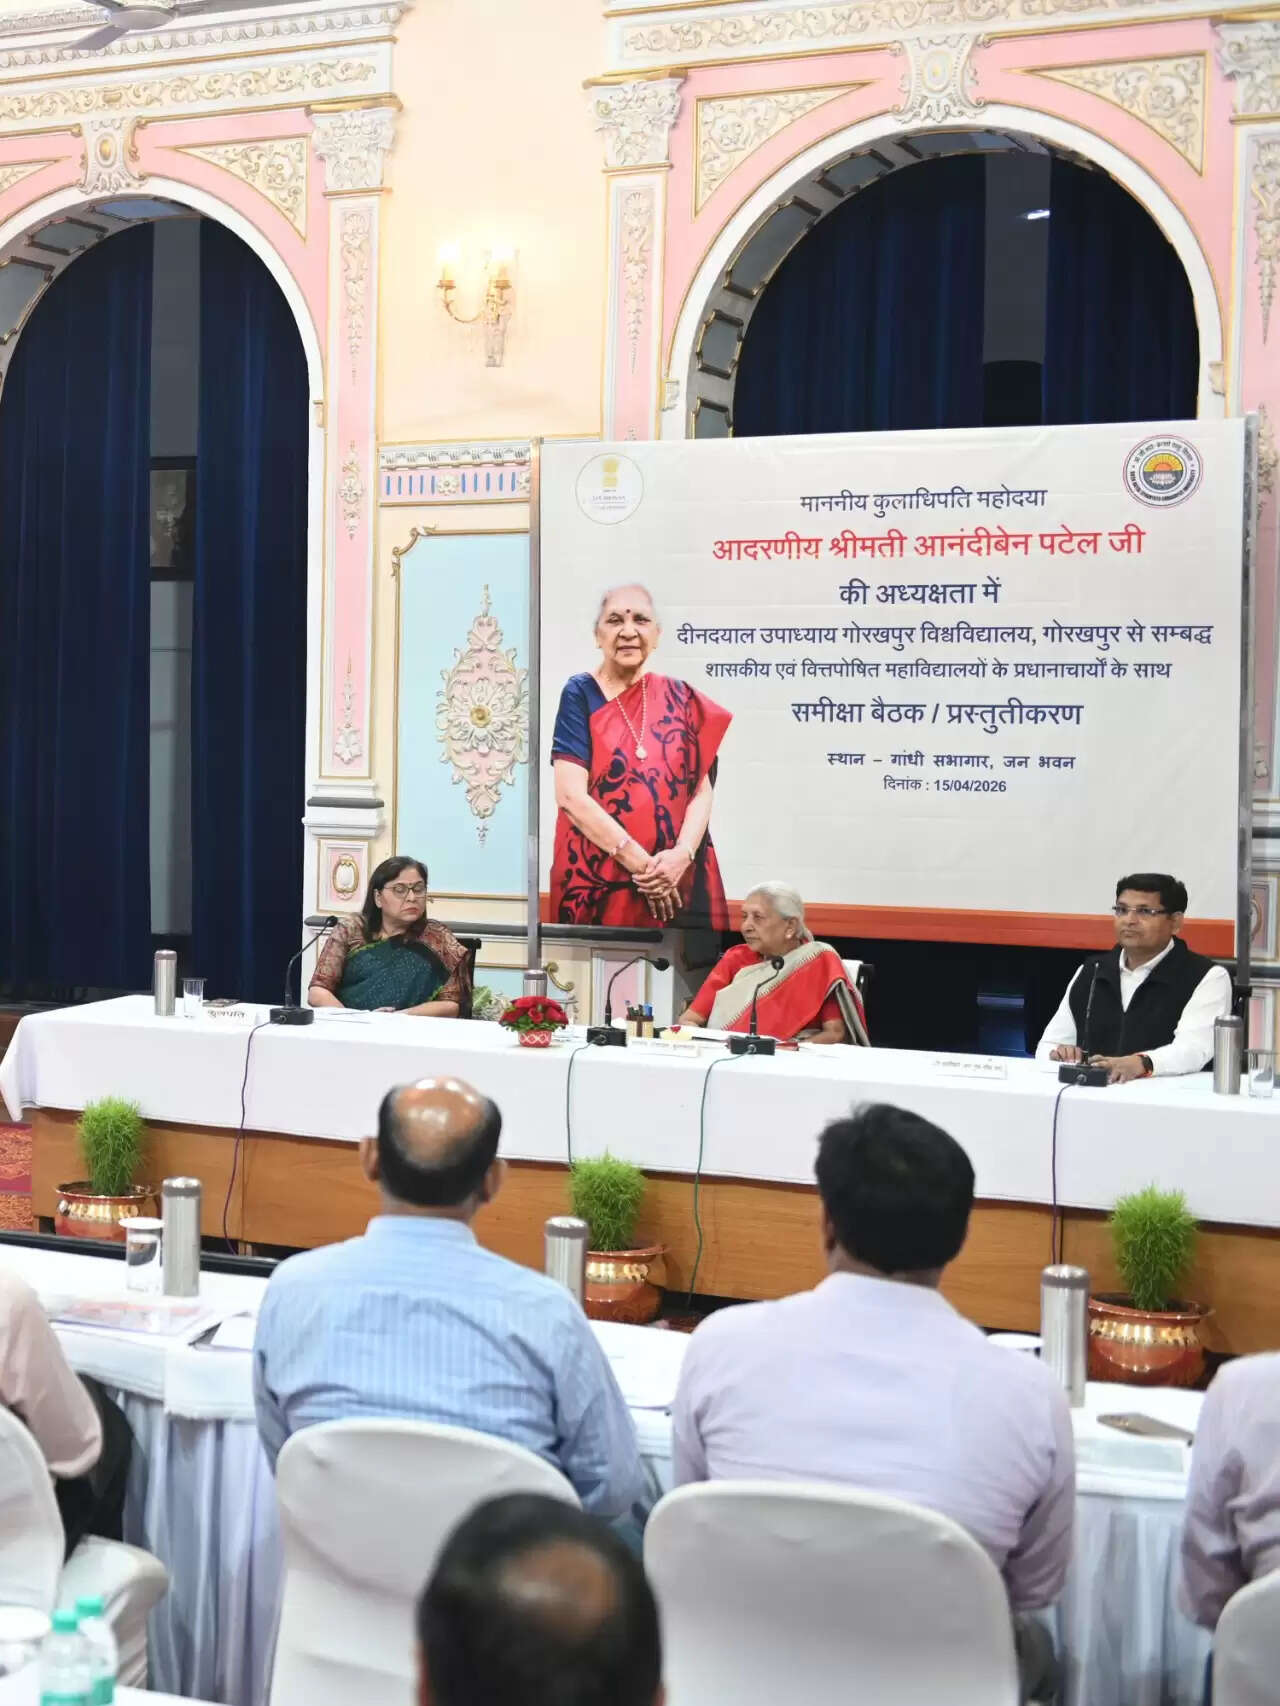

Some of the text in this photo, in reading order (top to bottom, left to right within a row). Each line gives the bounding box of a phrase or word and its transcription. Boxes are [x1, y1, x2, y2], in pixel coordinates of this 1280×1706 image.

[799, 484, 1049, 518] माननीय कुलाधिपति महोदया
[712, 523, 1148, 561] आदरणीय श्रीमती आनंदीबेन पटेल जी
[838, 575, 1002, 605] की अध्यक्षता में
[676, 618, 1215, 652] दीनदयाल उपाध्याय गोरखपुर विश्वविद्यालय, गोरखपुर से सम्बद्ध
[705, 656, 1173, 681] शासकीय एवं वित्तपोषित महाविद्यालयों के प्रधानाचार्यों के साथ
[791, 696, 1085, 735] समीक्षा बैठक / प्रस्तुतीकरण
[826, 752, 866, 766] स्थान
[890, 750, 925, 767] गांधी
[933, 754, 994, 770] सभागार,
[1003, 755, 1031, 769] जन
[1038, 756, 1077, 770] भवन
[883, 774, 924, 791] दिनांक
[934, 779, 1008, 792] 15/04/2026
